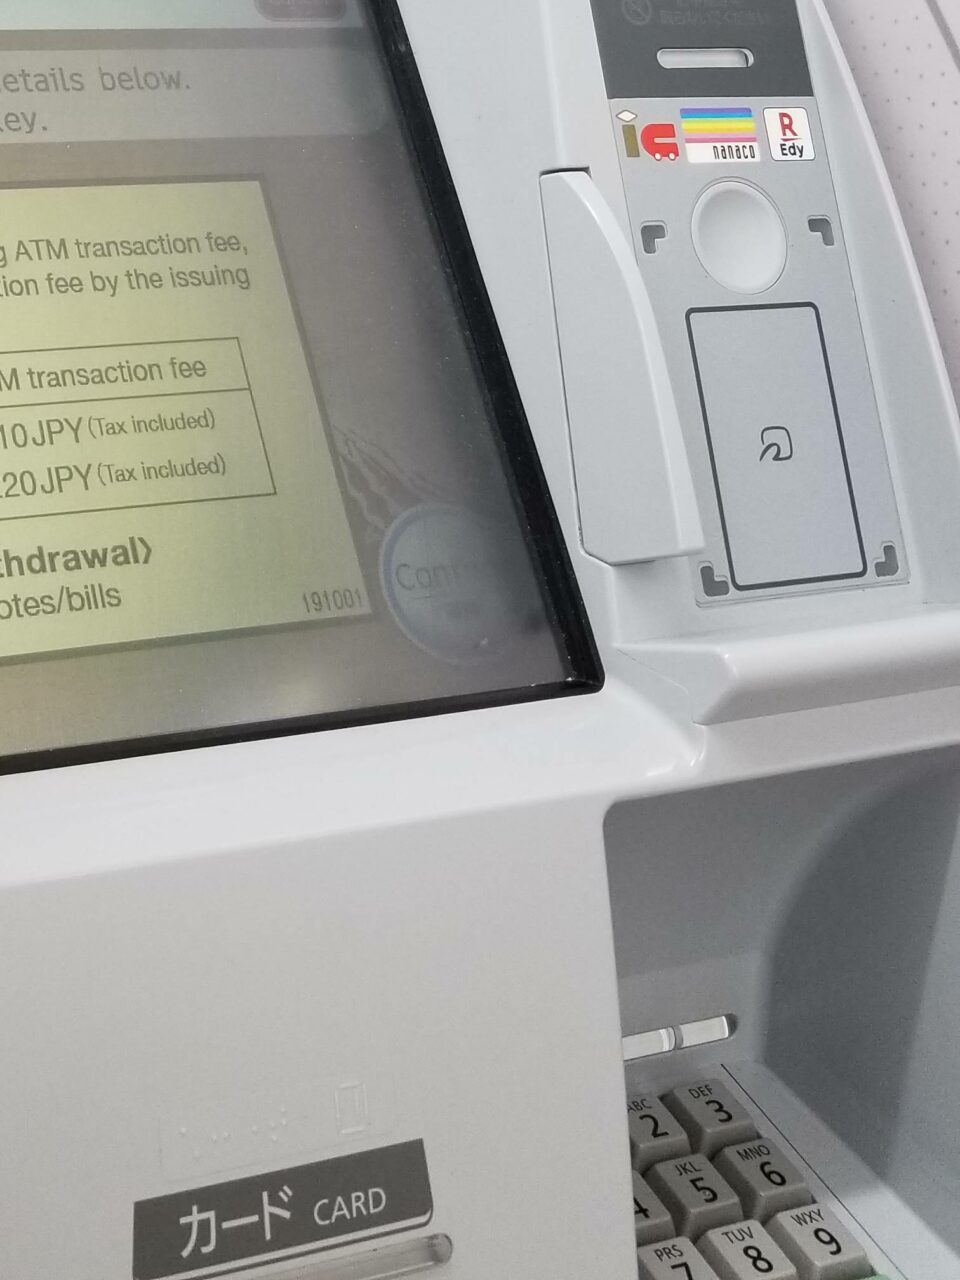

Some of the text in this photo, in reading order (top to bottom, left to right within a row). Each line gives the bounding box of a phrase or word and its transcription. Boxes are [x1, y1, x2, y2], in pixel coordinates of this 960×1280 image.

[98, 65, 191, 91] below.
[712, 144, 756, 161] nanaco
[779, 142, 804, 159] Edy
[14, 238, 69, 263] ATM
[73, 232, 202, 259] transaction
[204, 231, 248, 255] fee,
[45, 273, 84, 295] fee
[90, 271, 120, 297] by
[124, 267, 164, 289] the
[168, 264, 250, 290] issuing
[27, 359, 164, 390] transaction
[169, 357, 208, 380] fee
[131, 408, 216, 434] included)
[140, 453, 227, 480] included)
[302, 589, 364, 615] 191001
[688, 1084, 713, 1100] DEF
[705, 1099, 733, 1123] 3
[640, 1114, 669, 1138] 2
[736, 1144, 771, 1161] MNO
[674, 1162, 702, 1176] JKL
[759, 1161, 787, 1187] 6
[689, 1177, 718, 1203] 5
[313, 1187, 387, 1226] CARD
[791, 1209, 825, 1227] WXY
[179, 1185, 294, 1259] カード
[722, 1226, 754, 1245] TUV
[813, 1228, 842, 1256] 9
[654, 1244, 684, 1262] PRS
[742, 1245, 774, 1273] 8
[670, 1262, 695, 1280] 7
